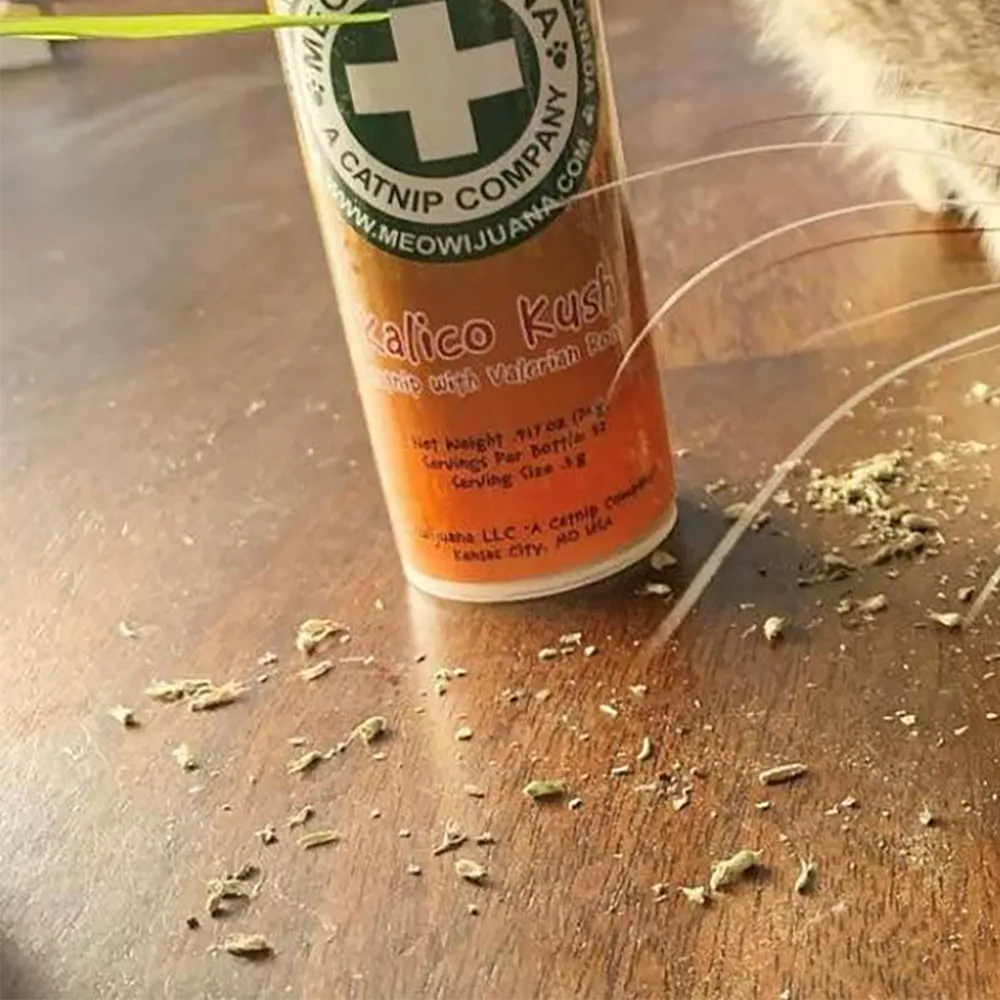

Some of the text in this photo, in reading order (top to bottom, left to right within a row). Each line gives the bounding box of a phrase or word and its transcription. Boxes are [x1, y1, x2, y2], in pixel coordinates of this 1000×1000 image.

[324, 85, 567, 214] A CATNIP COMPANY
[482, 526, 516, 543] LLC
